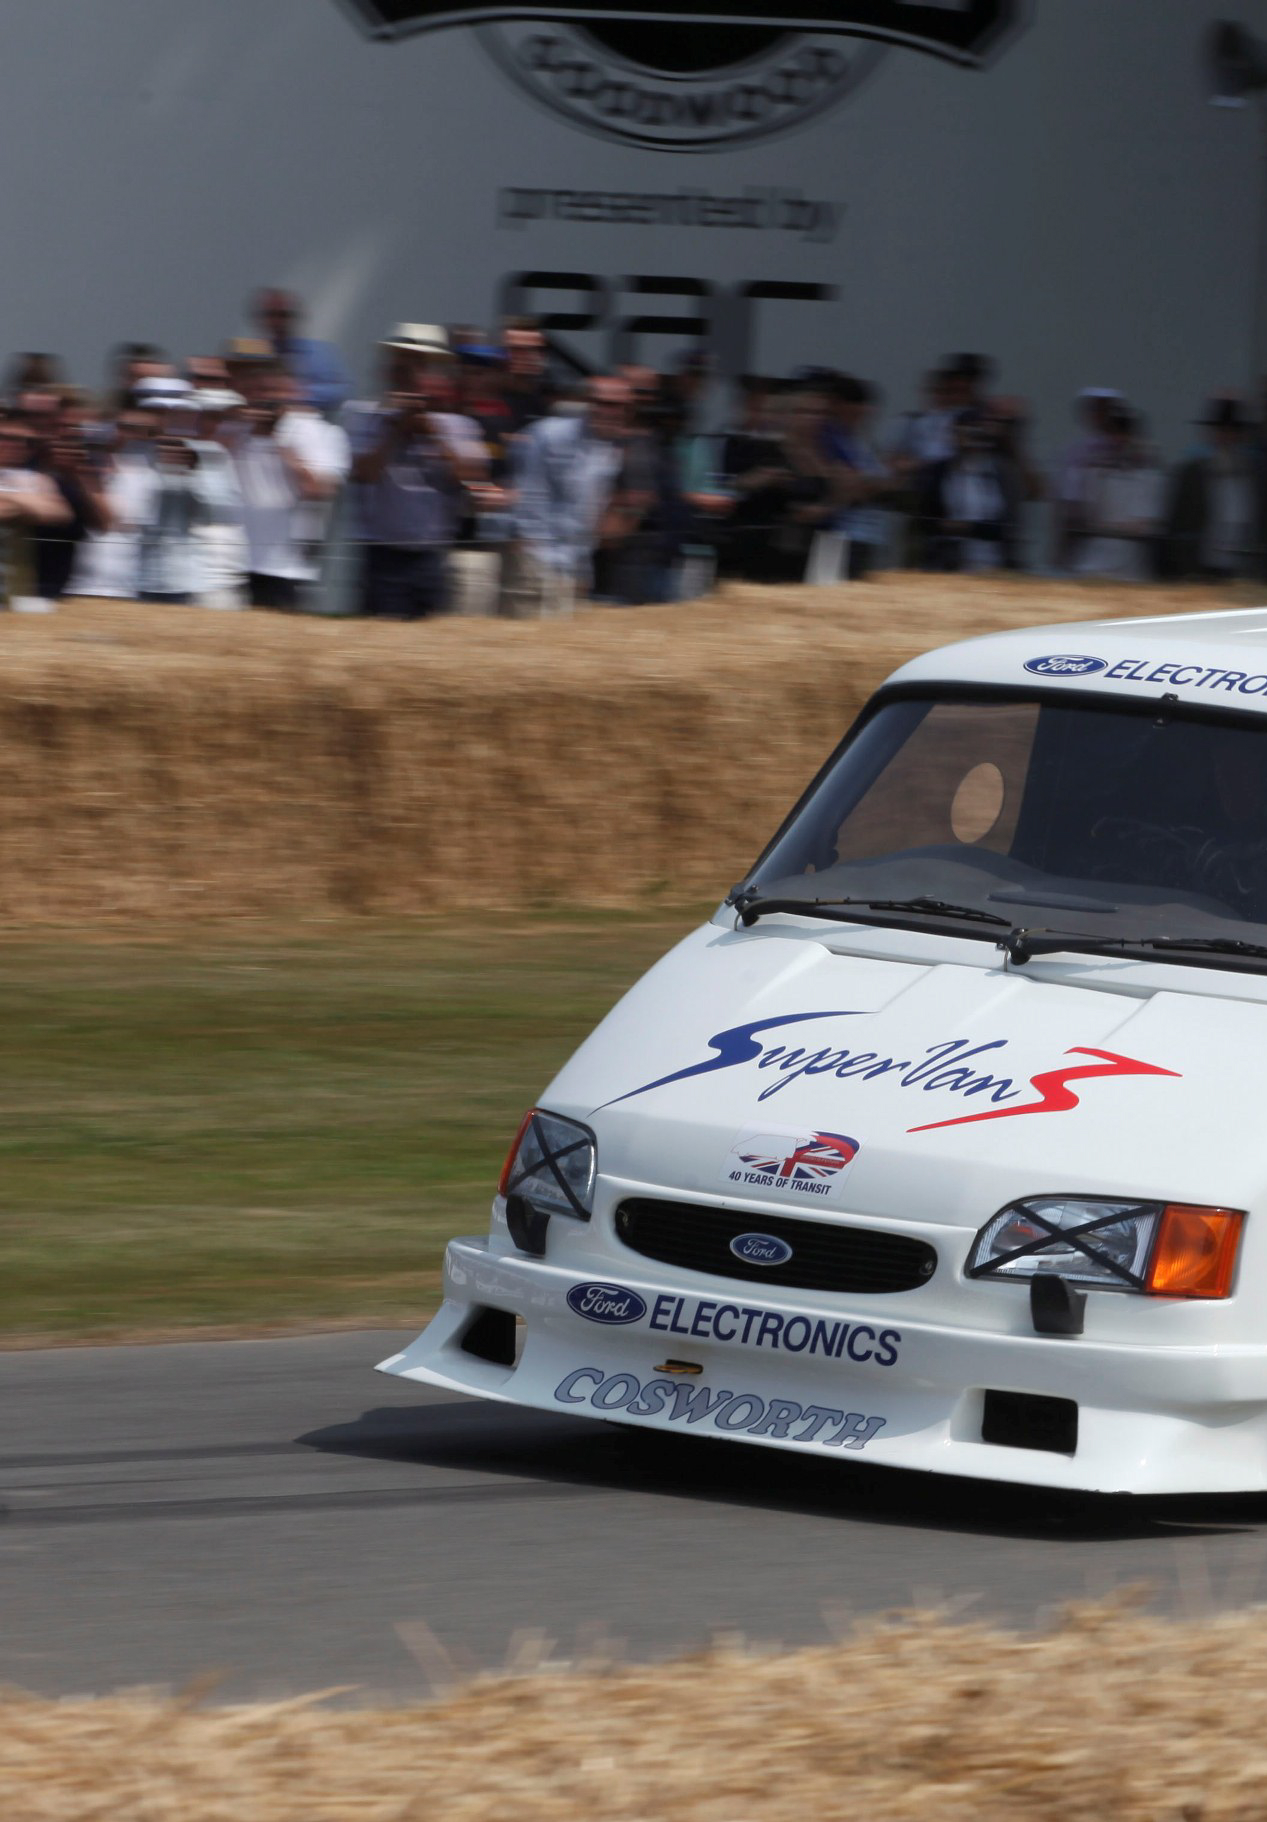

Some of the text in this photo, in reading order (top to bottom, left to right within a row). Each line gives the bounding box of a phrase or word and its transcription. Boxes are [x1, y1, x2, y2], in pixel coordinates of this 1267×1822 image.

[728, 1170, 832, 1195] 40 YEARS OF TRANSIT
[742, 1237, 779, 1261] Ford
[578, 1284, 903, 1368] Ford ELECTRONICS
[552, 1366, 888, 1450] COSWORTH
